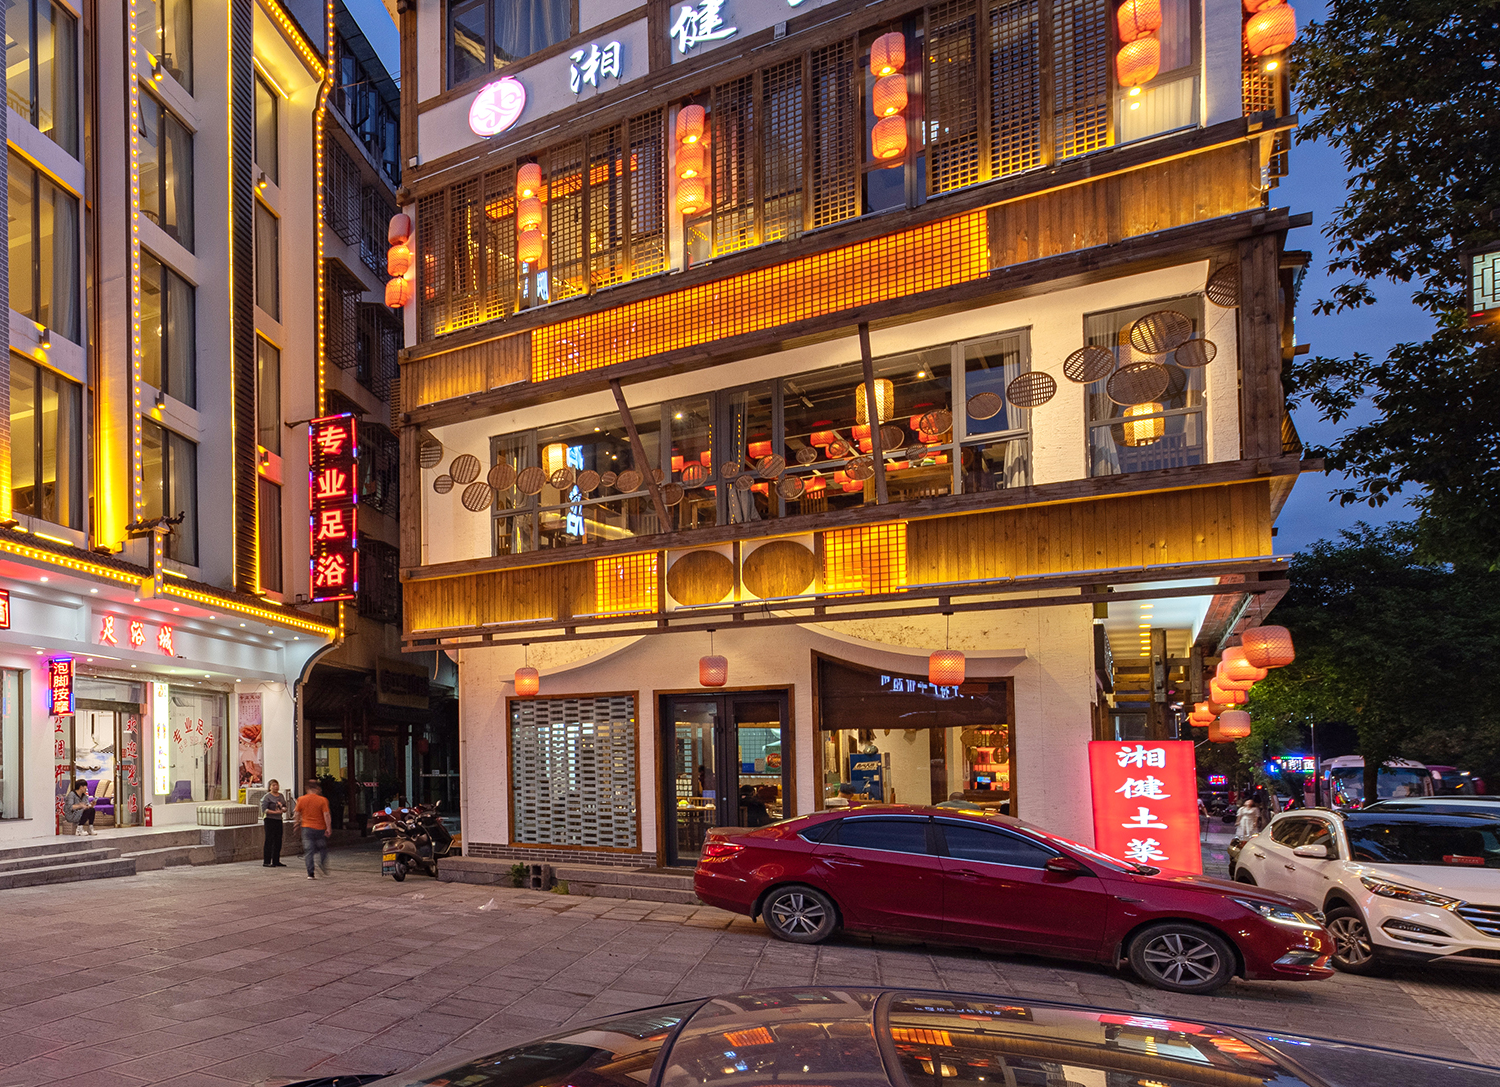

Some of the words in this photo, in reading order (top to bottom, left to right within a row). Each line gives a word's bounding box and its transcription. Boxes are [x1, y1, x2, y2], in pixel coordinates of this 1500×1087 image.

[316, 425, 348, 588] 专业足浴
[102, 615, 175, 657] 足浴城
[53, 662, 70, 713] 泡脚按摩
[126, 715, 139, 815] 欢迎光临
[1114, 744, 1172, 863] 湘健土菜
